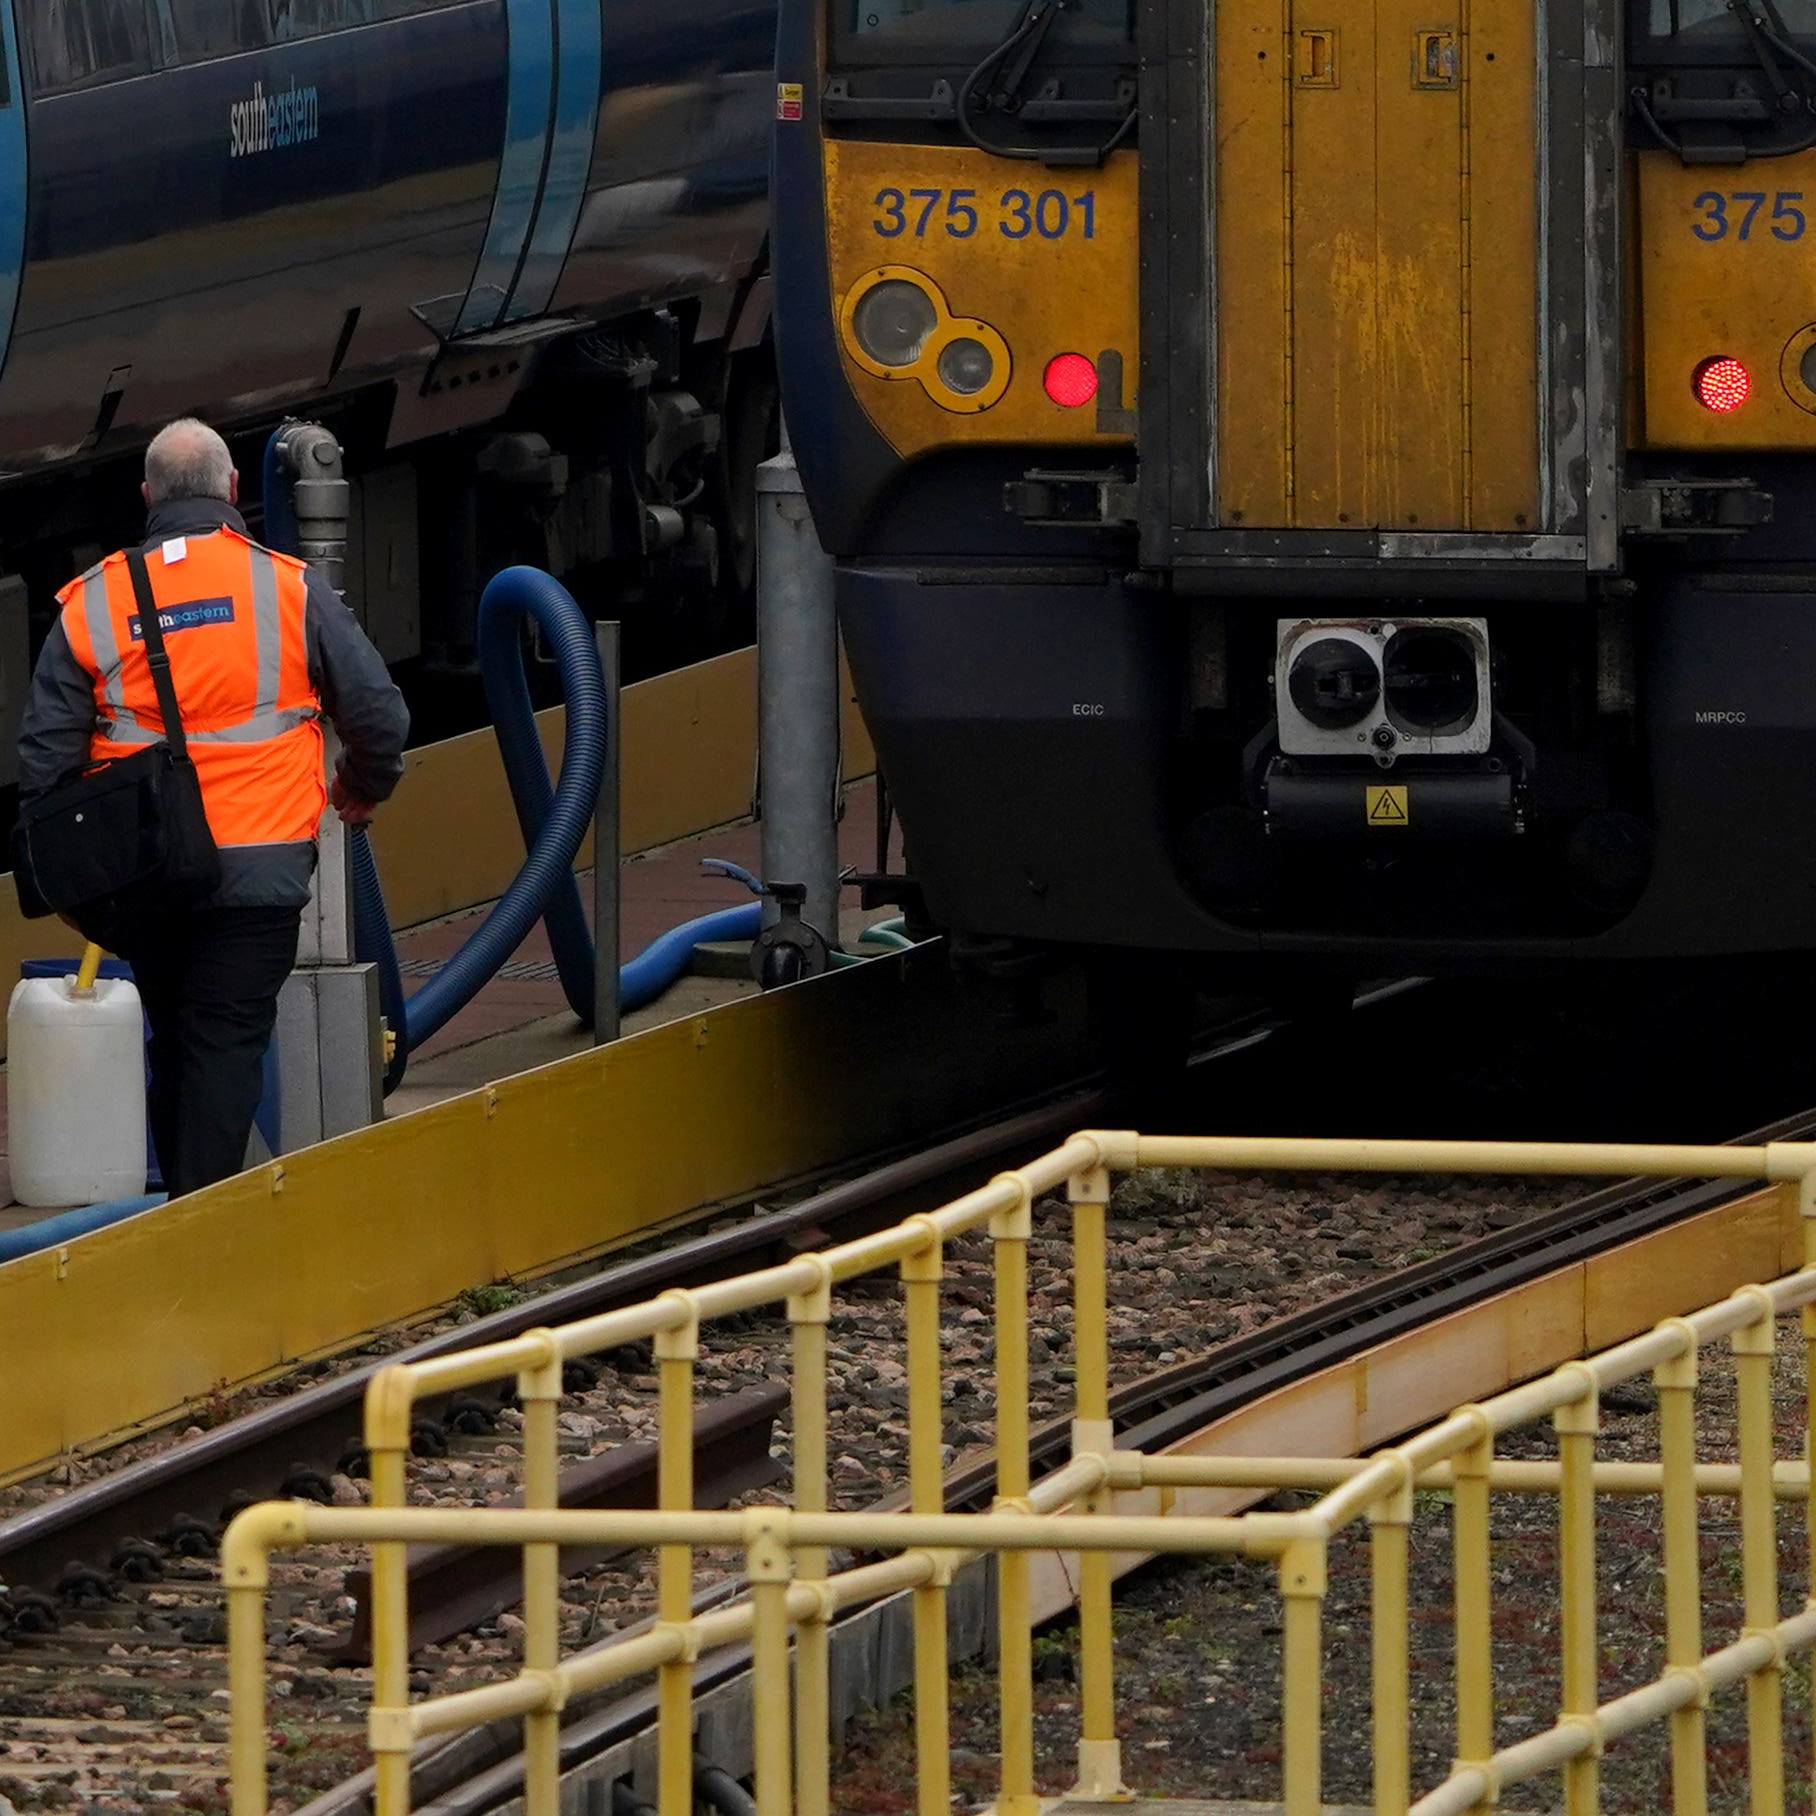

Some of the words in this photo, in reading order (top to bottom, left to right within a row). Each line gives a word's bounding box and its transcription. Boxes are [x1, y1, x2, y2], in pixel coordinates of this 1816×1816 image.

[230, 74, 318, 158] southeastern
[873, 188, 978, 239] 375
[999, 188, 1095, 239] 301
[1693, 191, 1806, 241] 375
[133, 606, 229, 635] stheastern
[1072, 703, 1105, 716] ECIC
[1695, 711, 1746, 724] MRPCC
